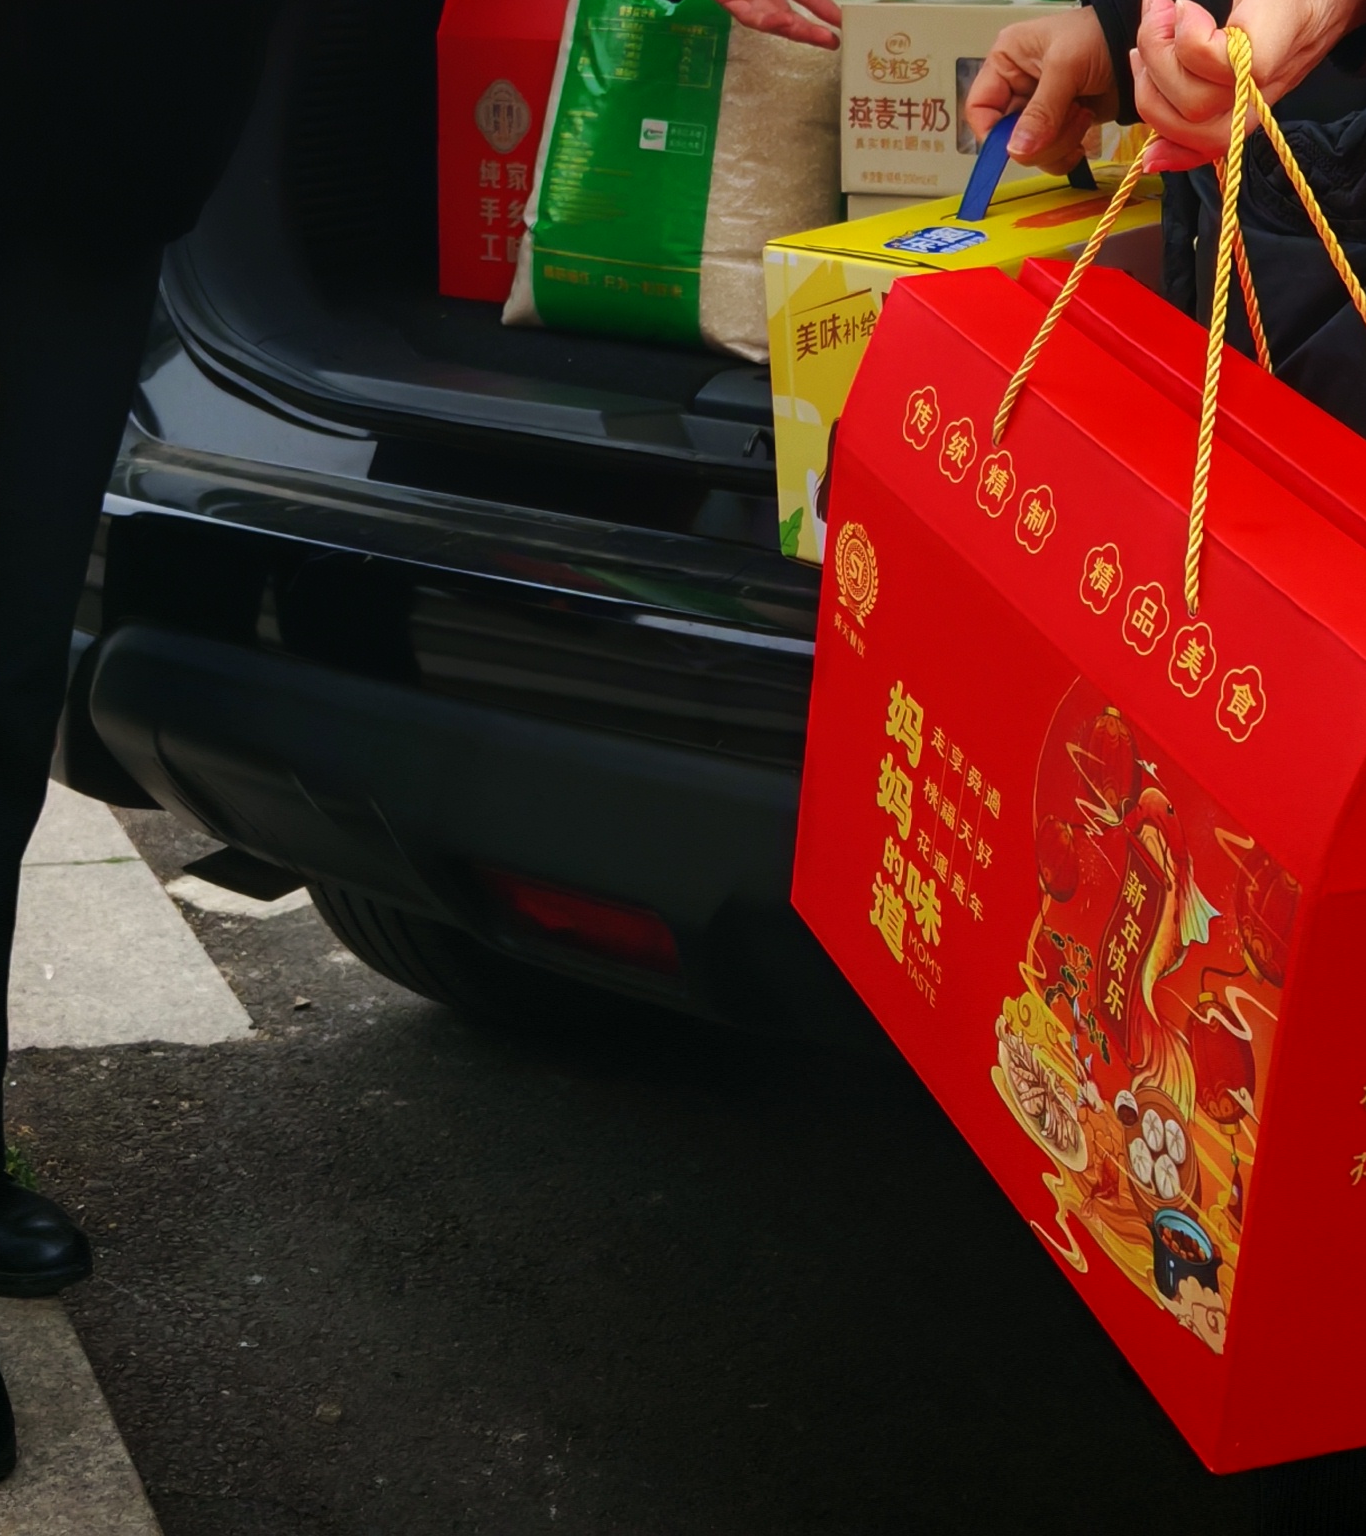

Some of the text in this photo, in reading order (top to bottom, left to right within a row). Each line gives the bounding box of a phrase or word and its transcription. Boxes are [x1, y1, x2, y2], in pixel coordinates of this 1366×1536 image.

[868, 50, 930, 81] 谷粒多
[848, 96, 950, 133] 燕麦牛奶
[479, 159, 502, 262] 纯手工
[796, 310, 876, 362] 美味补给
[908, 400, 1259, 725] 传统精制 精品美食
[870, 680, 941, 963] 妈妈的味道
[908, 929, 942, 985] MOM'S
[1101, 869, 1149, 1022] 新年快乐
[906, 956, 936, 1009] TASTE
